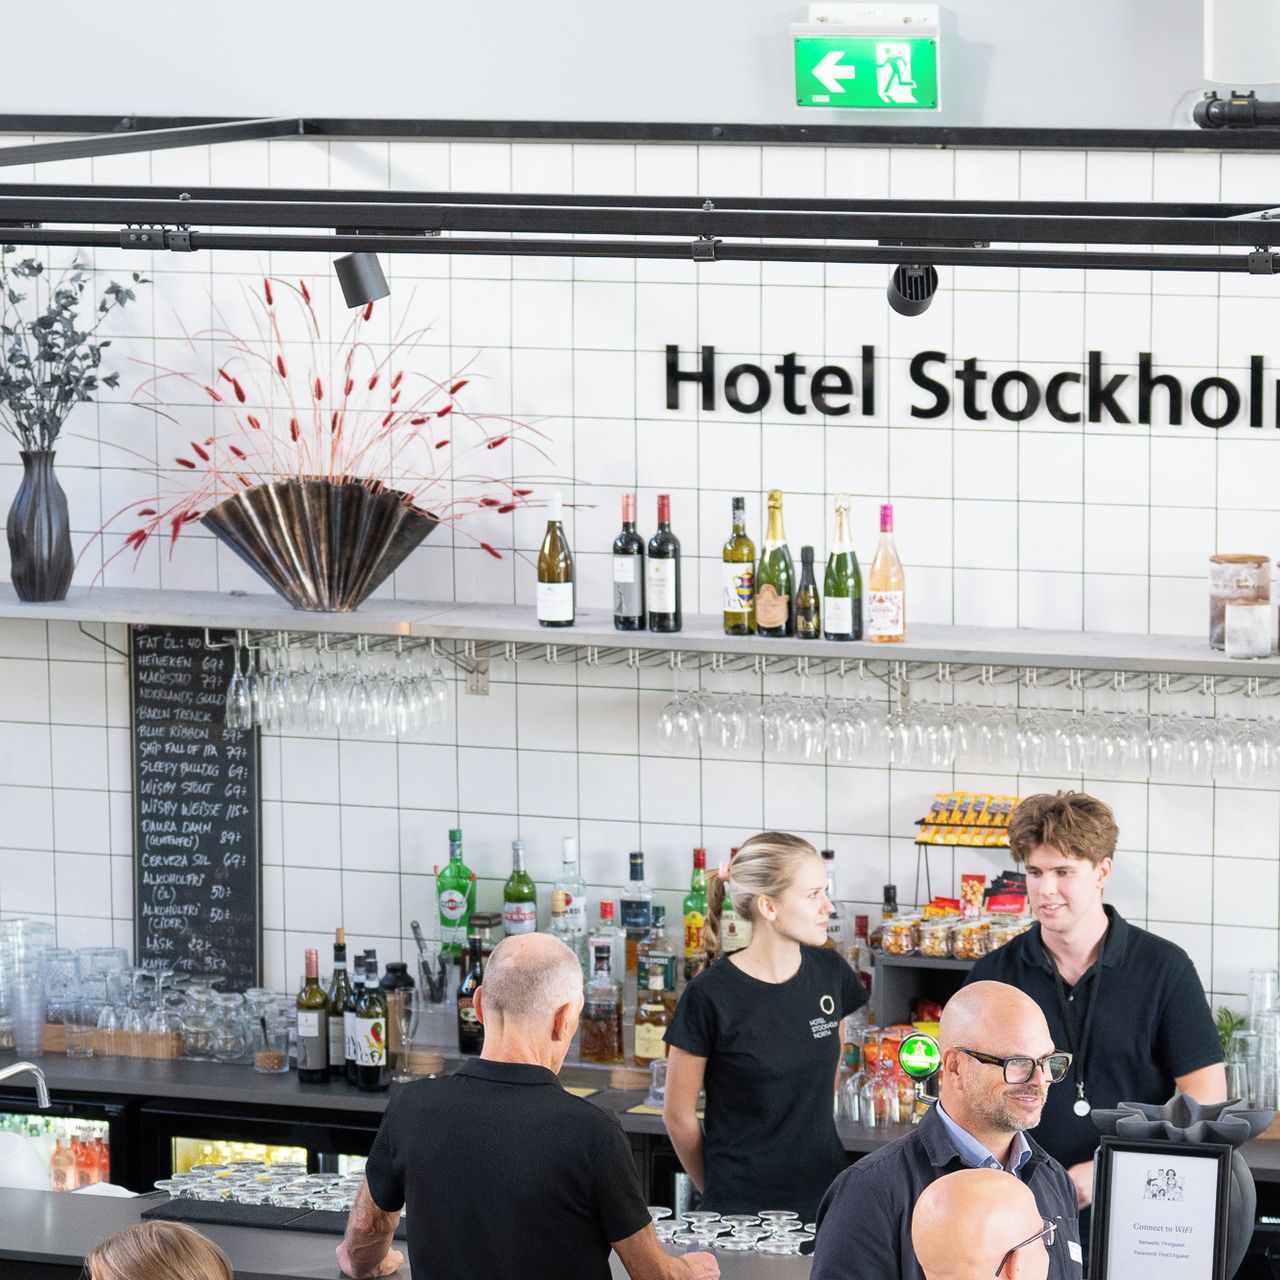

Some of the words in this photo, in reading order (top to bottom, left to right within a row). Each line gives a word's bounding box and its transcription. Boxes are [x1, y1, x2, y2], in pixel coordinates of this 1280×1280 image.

[666, 344, 875, 415] Hotel
[136, 636, 162, 648] FAT
[187, 638, 201, 649] 40
[137, 724, 166, 738] BLUE
[140, 760, 178, 776] SLEEPY
[181, 781, 214, 795] STOUT
[140, 819, 178, 833] DAURA
[141, 853, 189, 867] CERVEZA
[192, 854, 212, 866] SOL
[1133, 1222, 1164, 1232] Connect
[1174, 1225, 1193, 1234] WiFi
